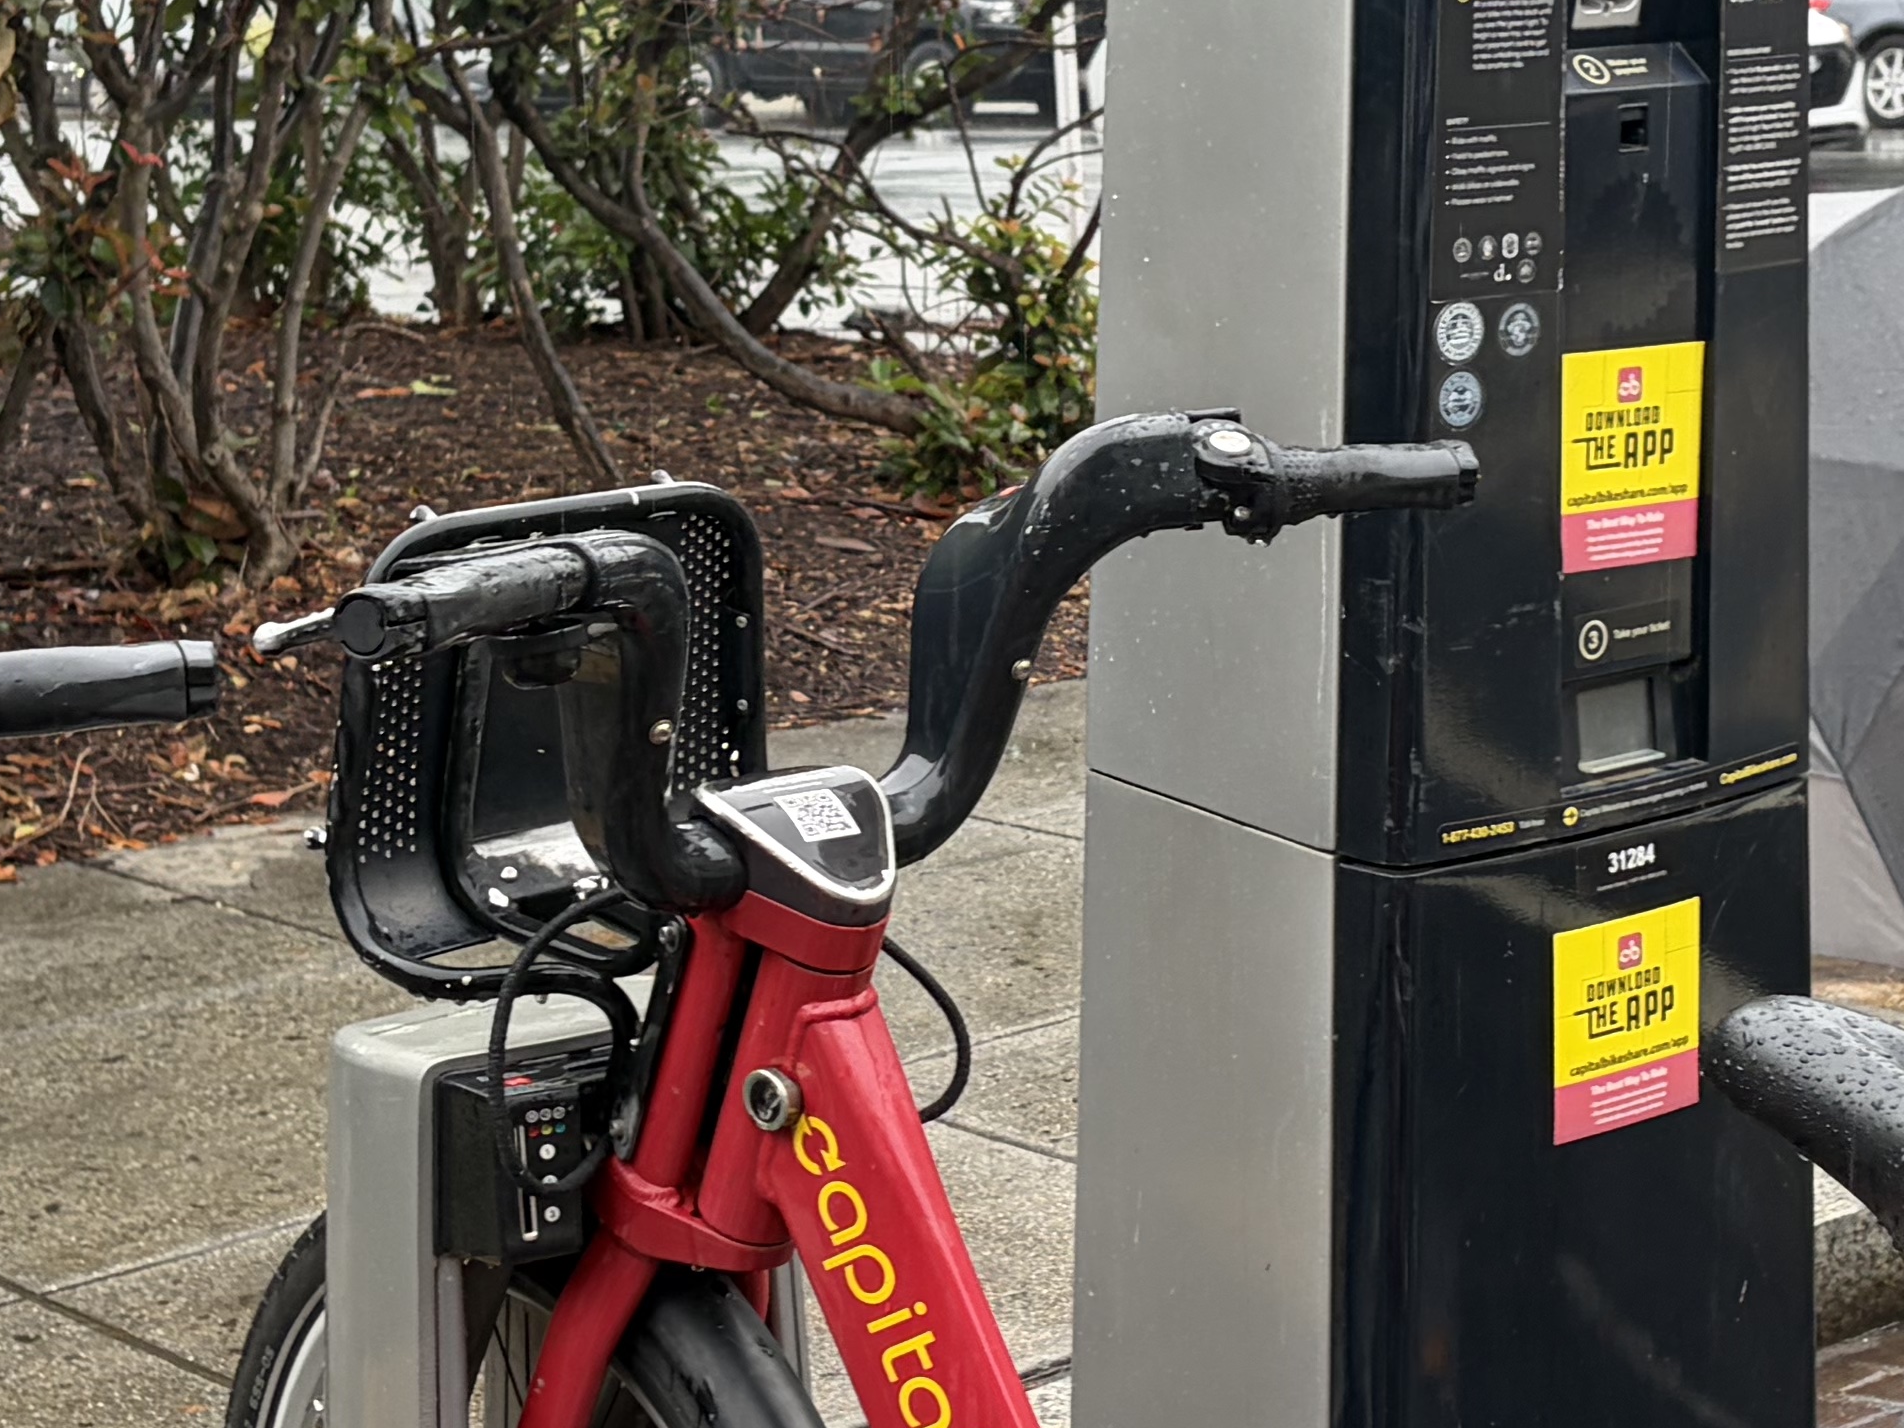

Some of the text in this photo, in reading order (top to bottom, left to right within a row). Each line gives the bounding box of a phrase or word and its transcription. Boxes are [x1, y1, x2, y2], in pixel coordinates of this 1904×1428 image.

[1586, 406, 1661, 432] DOWNLOAD
[1572, 428, 1673, 470] THE APP
[1607, 843, 1657, 873] 31284
[1587, 966, 1661, 1002] DOWNLOAD
[1573, 985, 1674, 1040] THE APP
